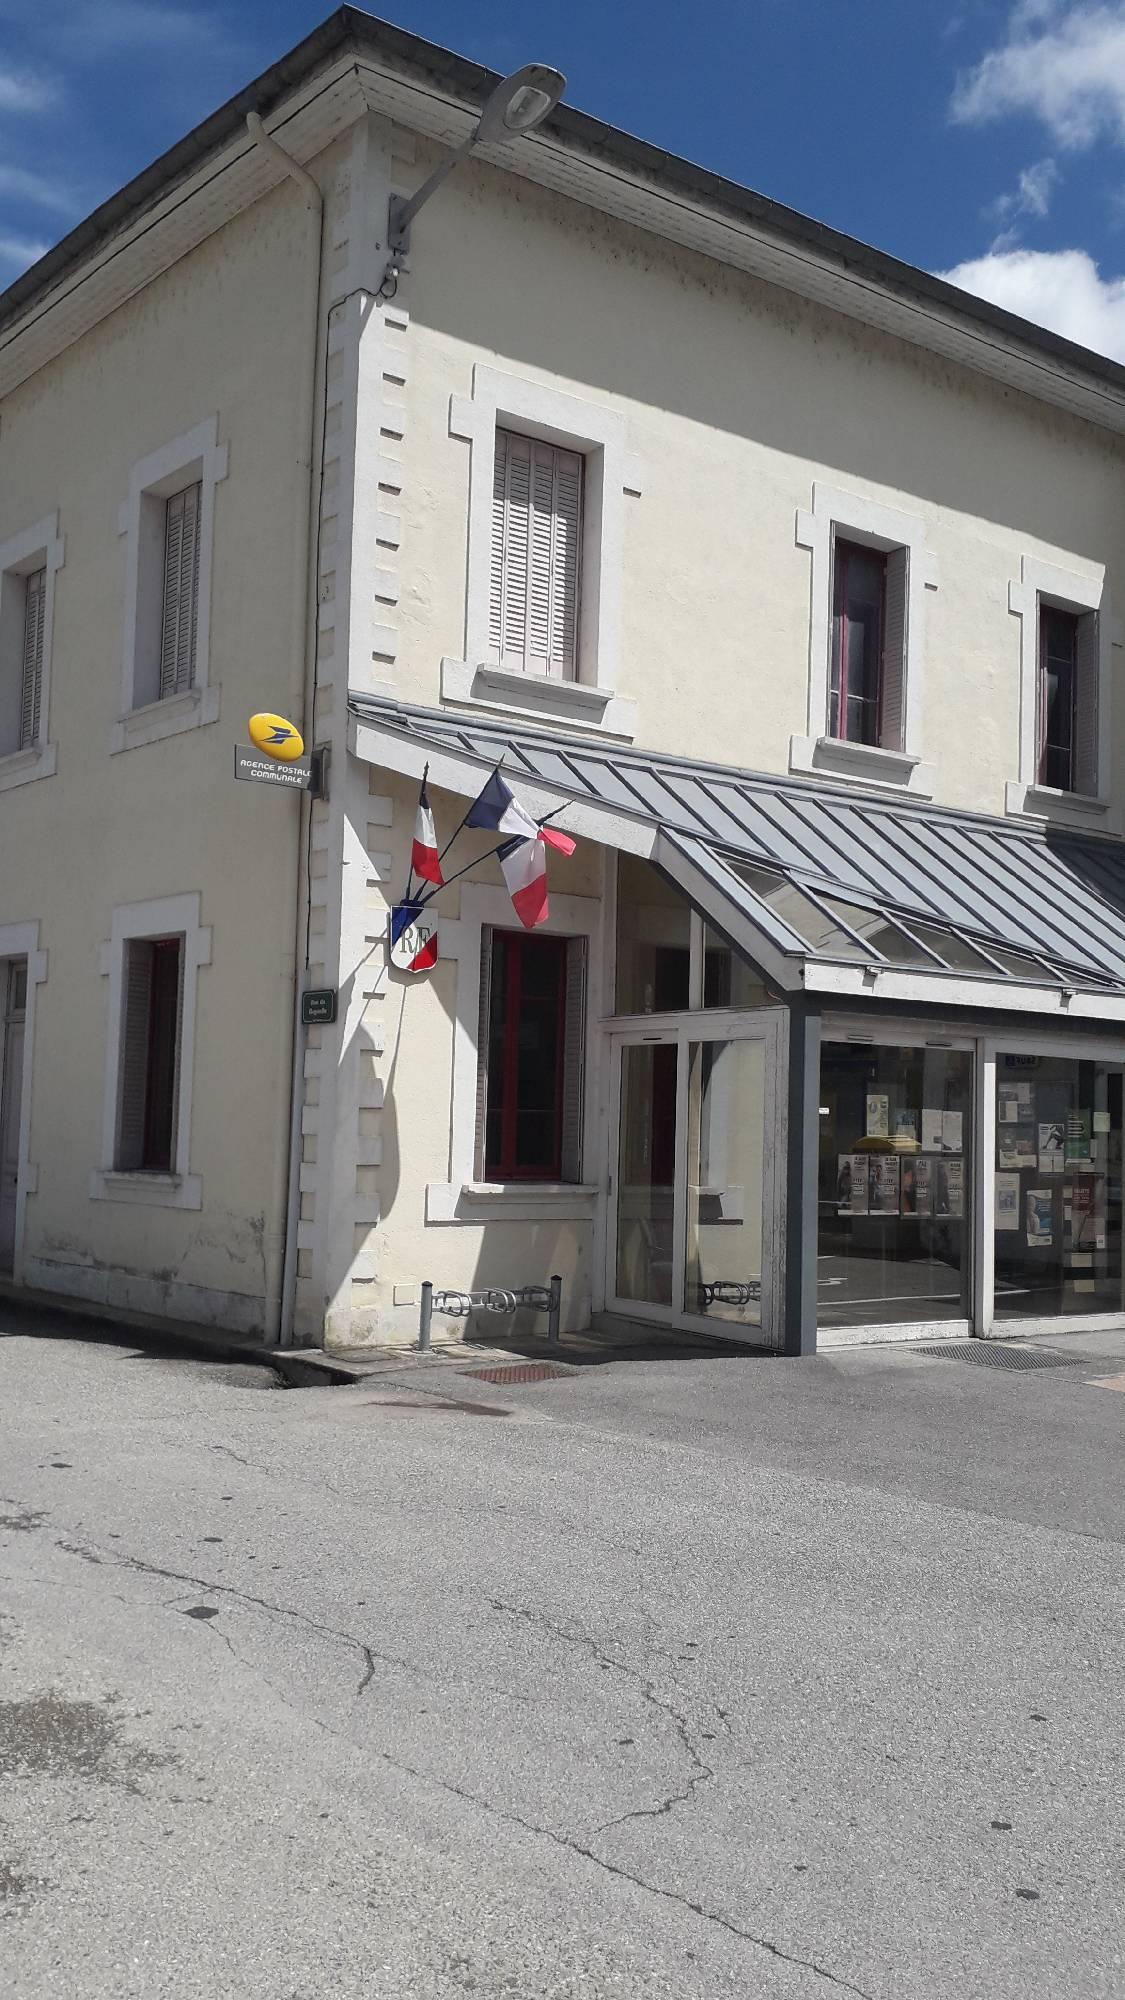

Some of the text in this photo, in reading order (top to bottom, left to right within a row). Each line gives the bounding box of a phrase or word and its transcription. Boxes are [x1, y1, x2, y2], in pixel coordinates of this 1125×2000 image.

[240, 760, 312, 777] AGENCE POSTALE
[250, 769, 302, 784] COMMUNALE
[399, 926, 431, 954] RF
